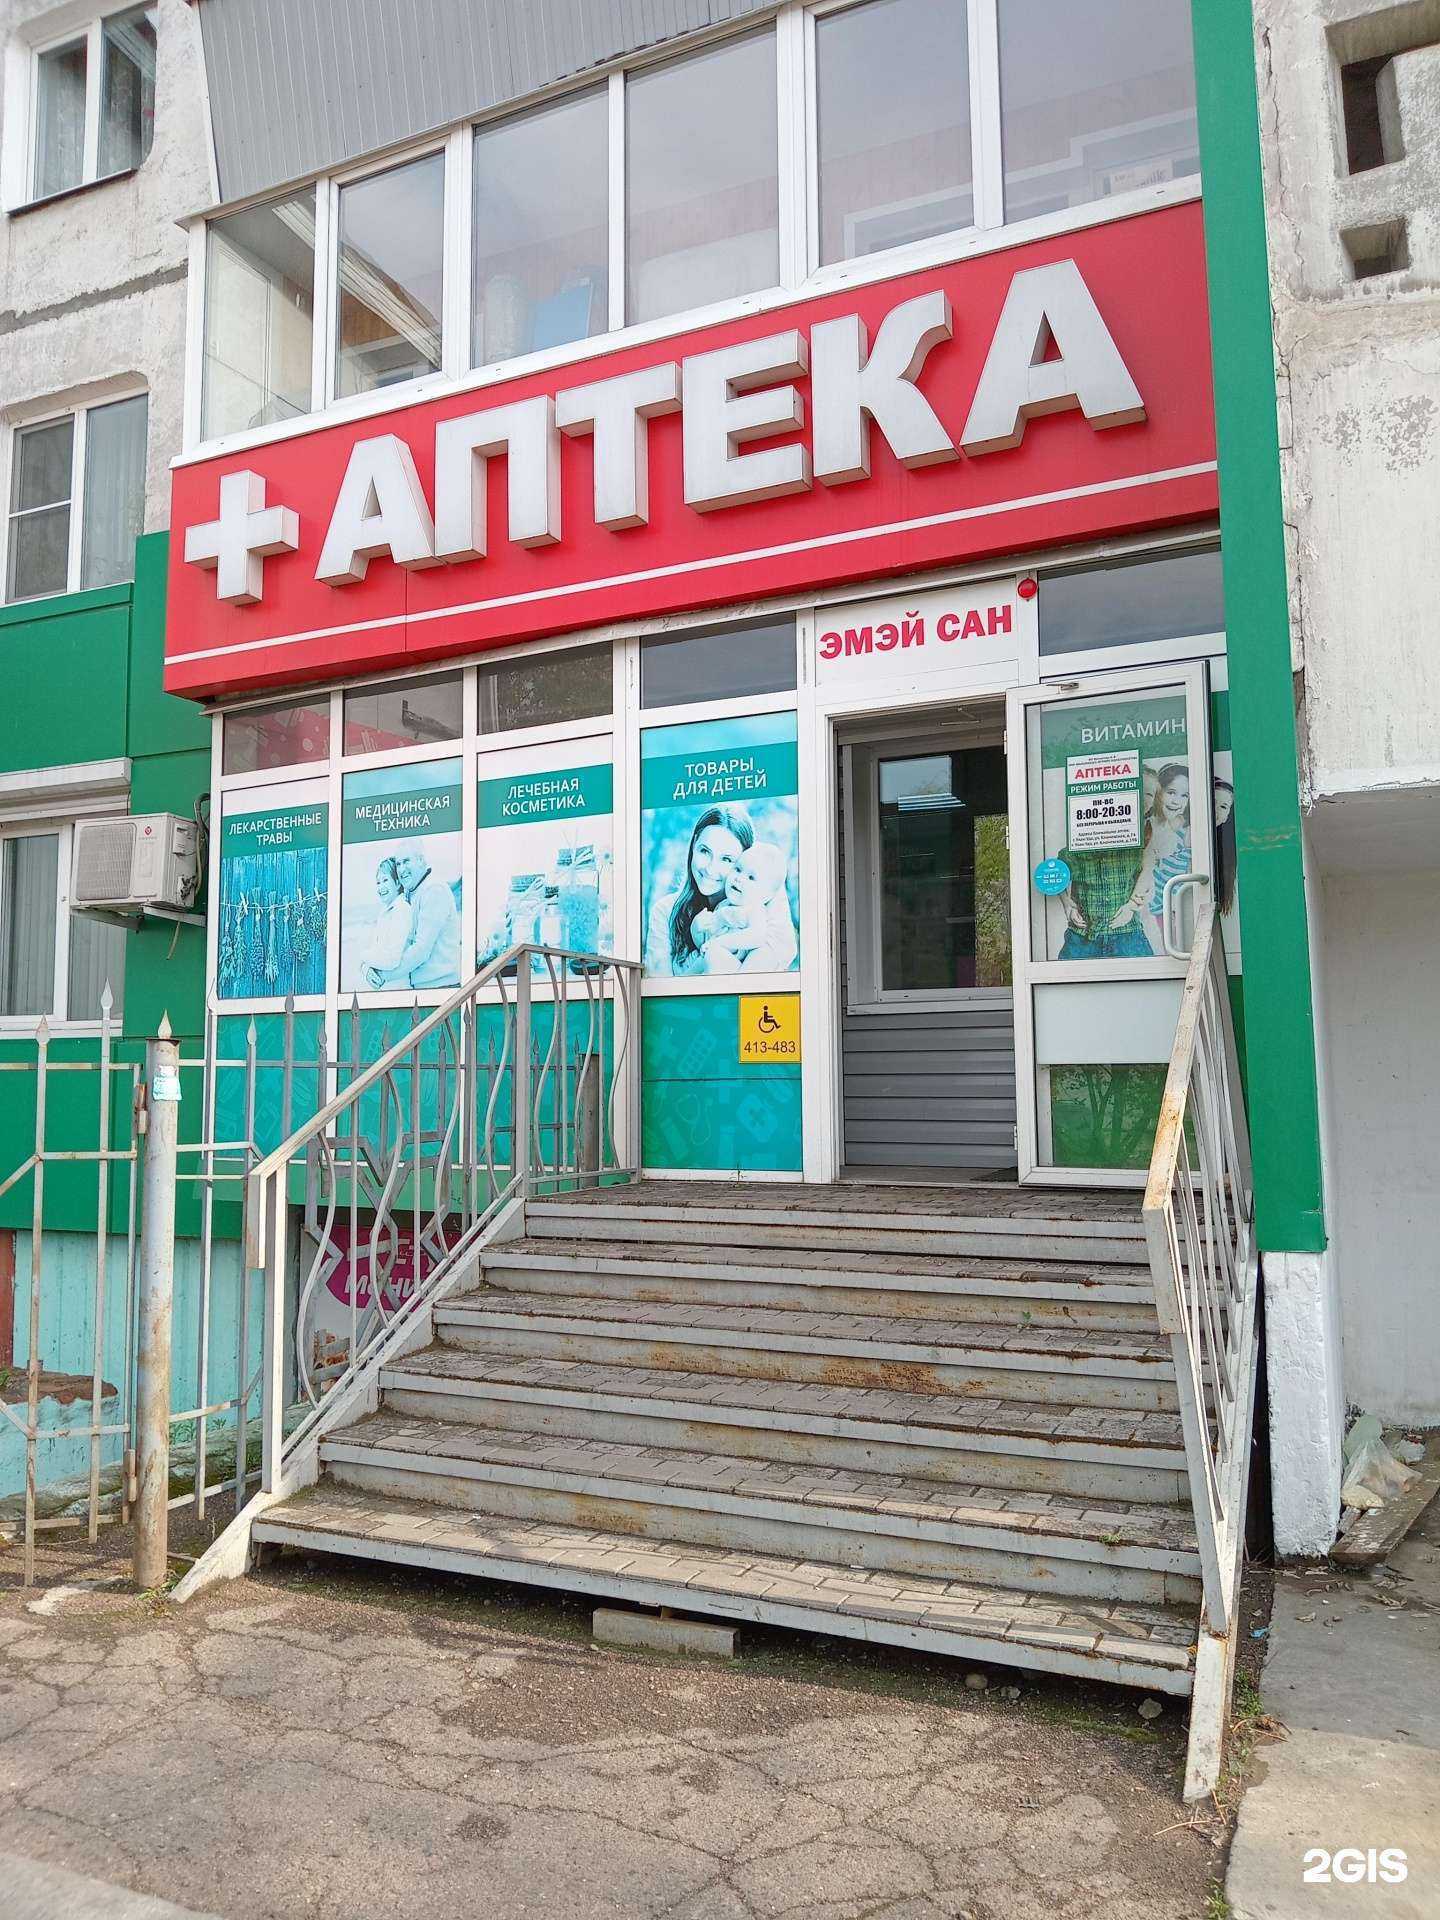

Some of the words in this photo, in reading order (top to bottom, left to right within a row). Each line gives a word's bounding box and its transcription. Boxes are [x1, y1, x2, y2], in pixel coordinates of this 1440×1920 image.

[313, 258, 1147, 587] АПТЕКА
[819, 610, 925, 660] ЭМЭЙ
[936, 604, 1012, 642] САН
[1081, 717, 1186, 744] ВИТАМИН
[684, 757, 755, 778] ТОВАРЫ
[1074, 764, 1132, 780] АПТЕКА
[507, 777, 580, 800] ЛЕЧЕБНАЯ
[672, 780, 708, 800] ДЛЯ
[711, 769, 767, 796] ДЕТЕЙ
[1070, 784, 1101, 794] РЕЖИМ
[1103, 781, 1137, 791] РАБОТЫ
[355, 795, 451, 820] МЕДИЦИНСКАЯ
[501, 794, 586, 817] КОСМЕТИКА
[1076, 805, 1132, 820] 8:00-20:30
[228, 812, 323, 836] ЛЕКАРСТВЕННЫЕ
[373, 814, 431, 832] ТЕХНИКА
[256, 831, 293, 847] ТРАВЫ
[743, 1040, 796, 1054] 413-483
